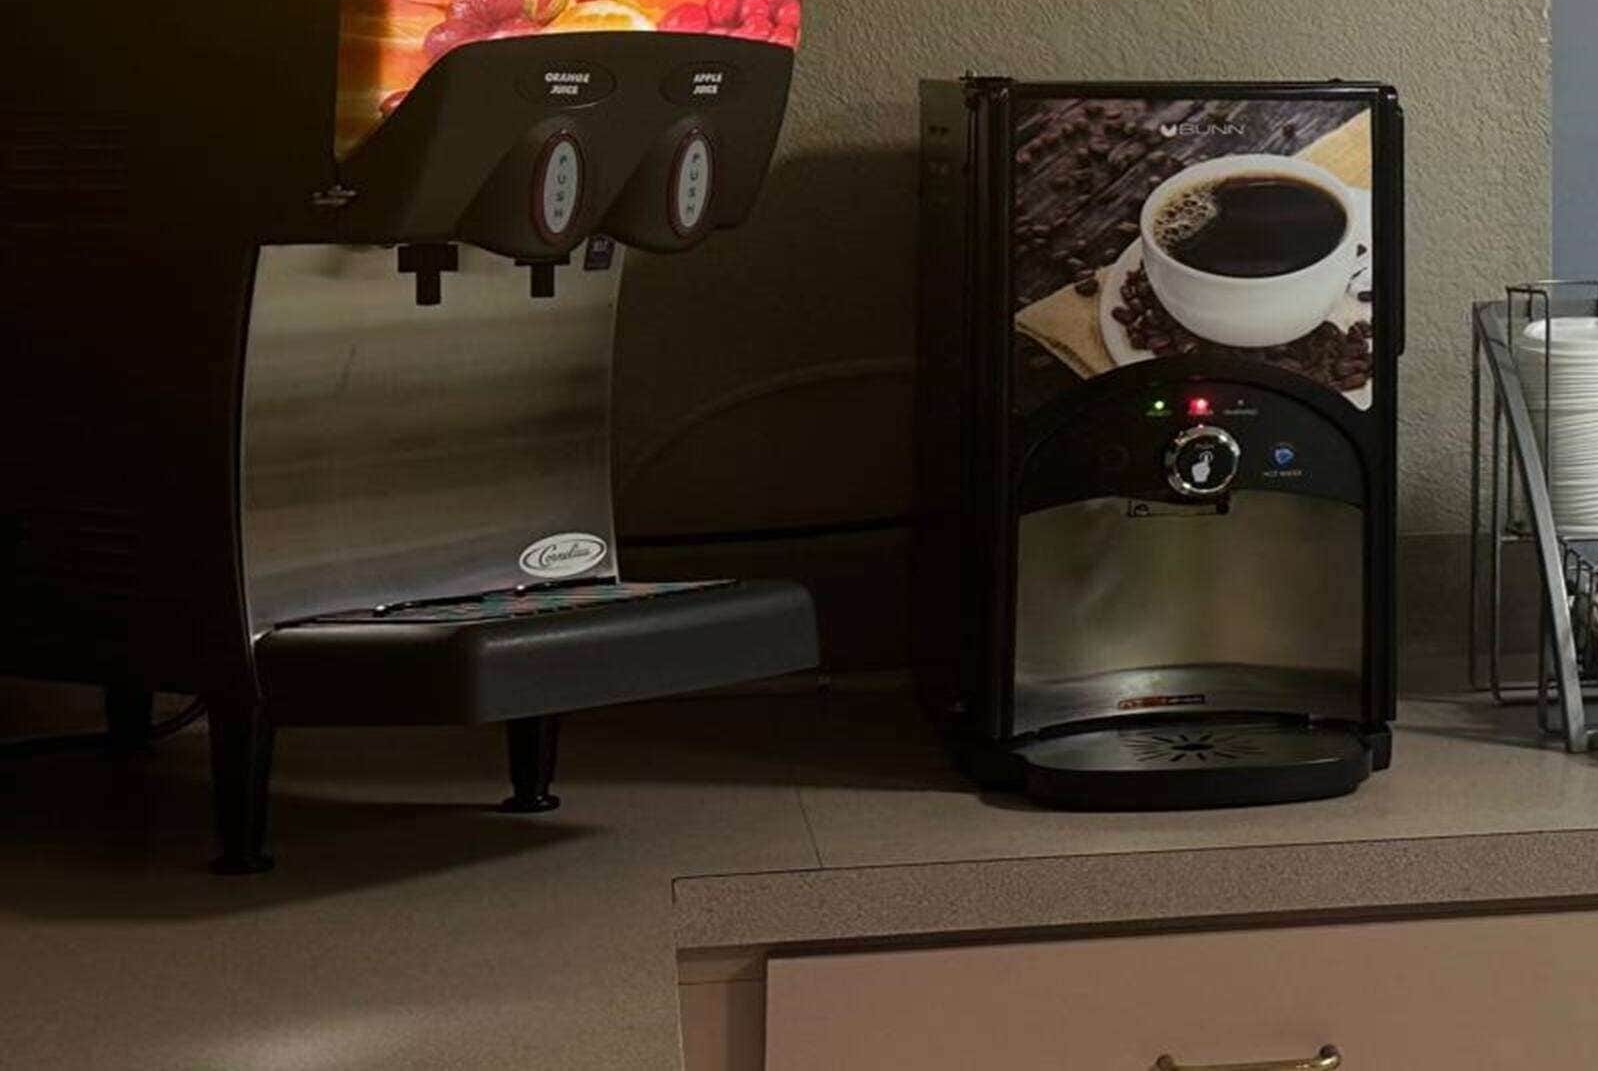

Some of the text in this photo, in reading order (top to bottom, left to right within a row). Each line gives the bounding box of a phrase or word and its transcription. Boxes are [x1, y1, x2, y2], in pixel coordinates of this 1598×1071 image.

[544, 72, 590, 84] ORANGE
[692, 72, 722, 83] APPLE
[550, 85, 578, 95] JUICE
[692, 85, 717, 95] JUICE
[1179, 123, 1246, 135] BUNN
